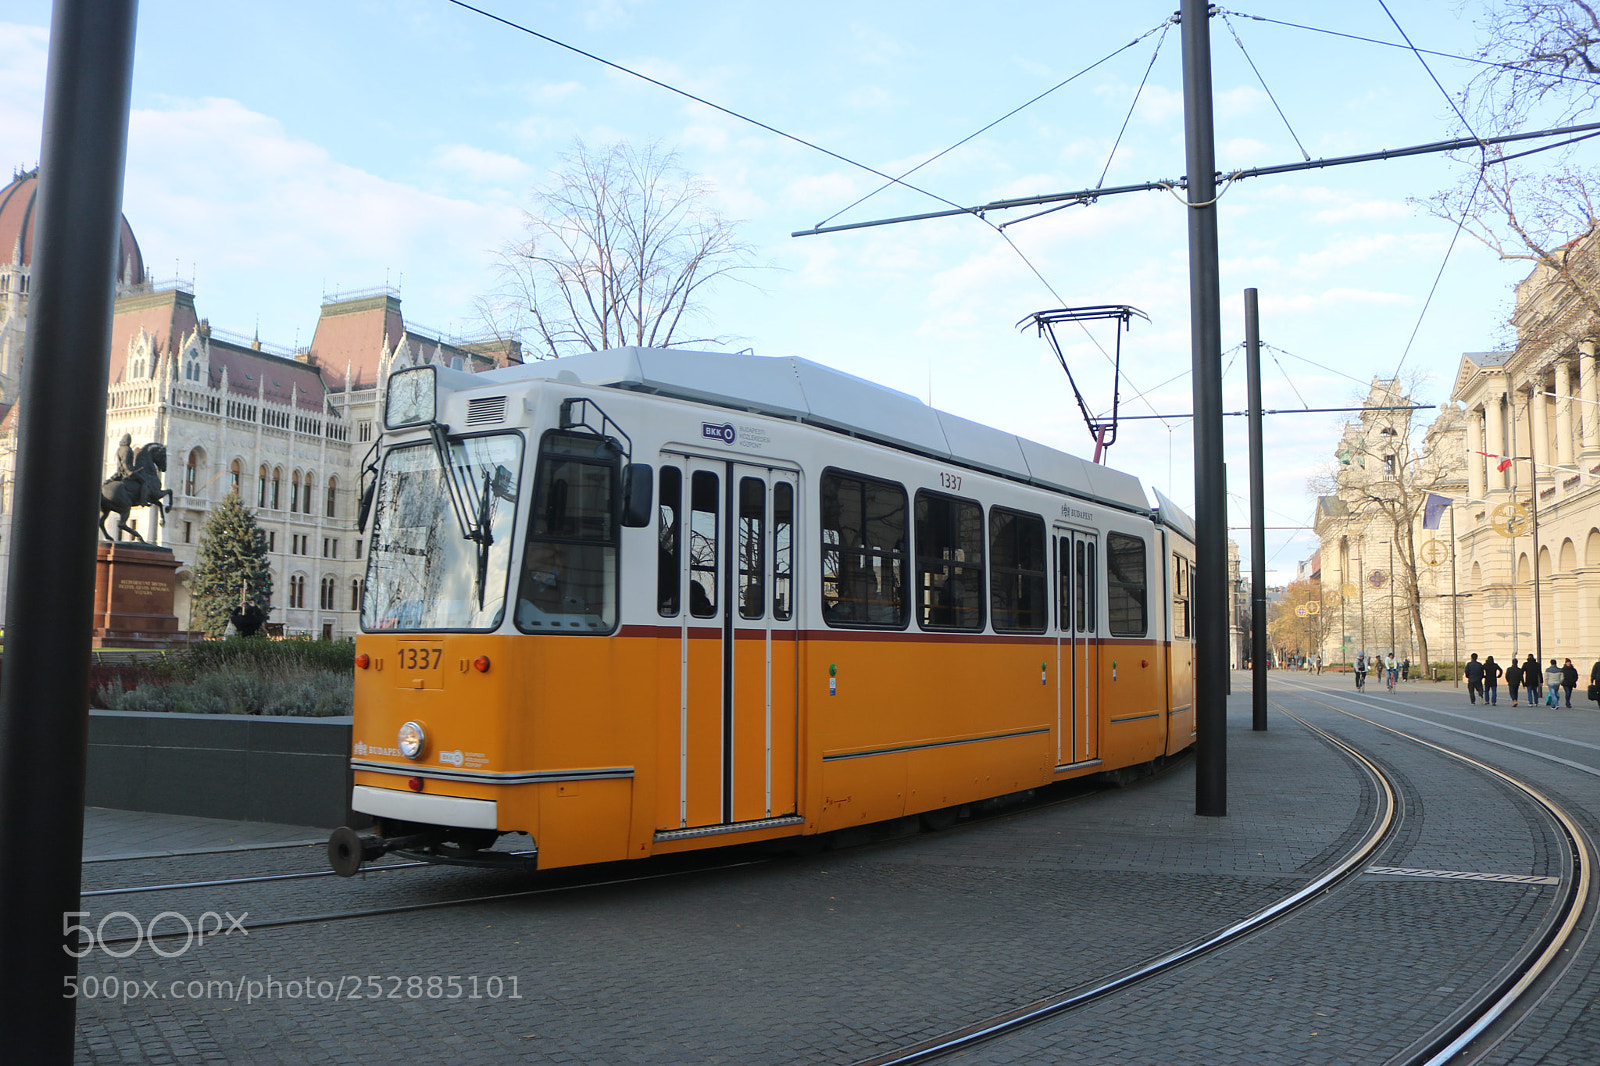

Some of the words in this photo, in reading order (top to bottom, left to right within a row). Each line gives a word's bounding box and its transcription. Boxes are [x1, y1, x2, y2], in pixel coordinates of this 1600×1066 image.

[939, 471, 962, 491] 1337
[1071, 508, 1093, 521] BUDAPEST
[397, 648, 443, 670] 1337
[368, 745, 405, 757] BUDAPES
